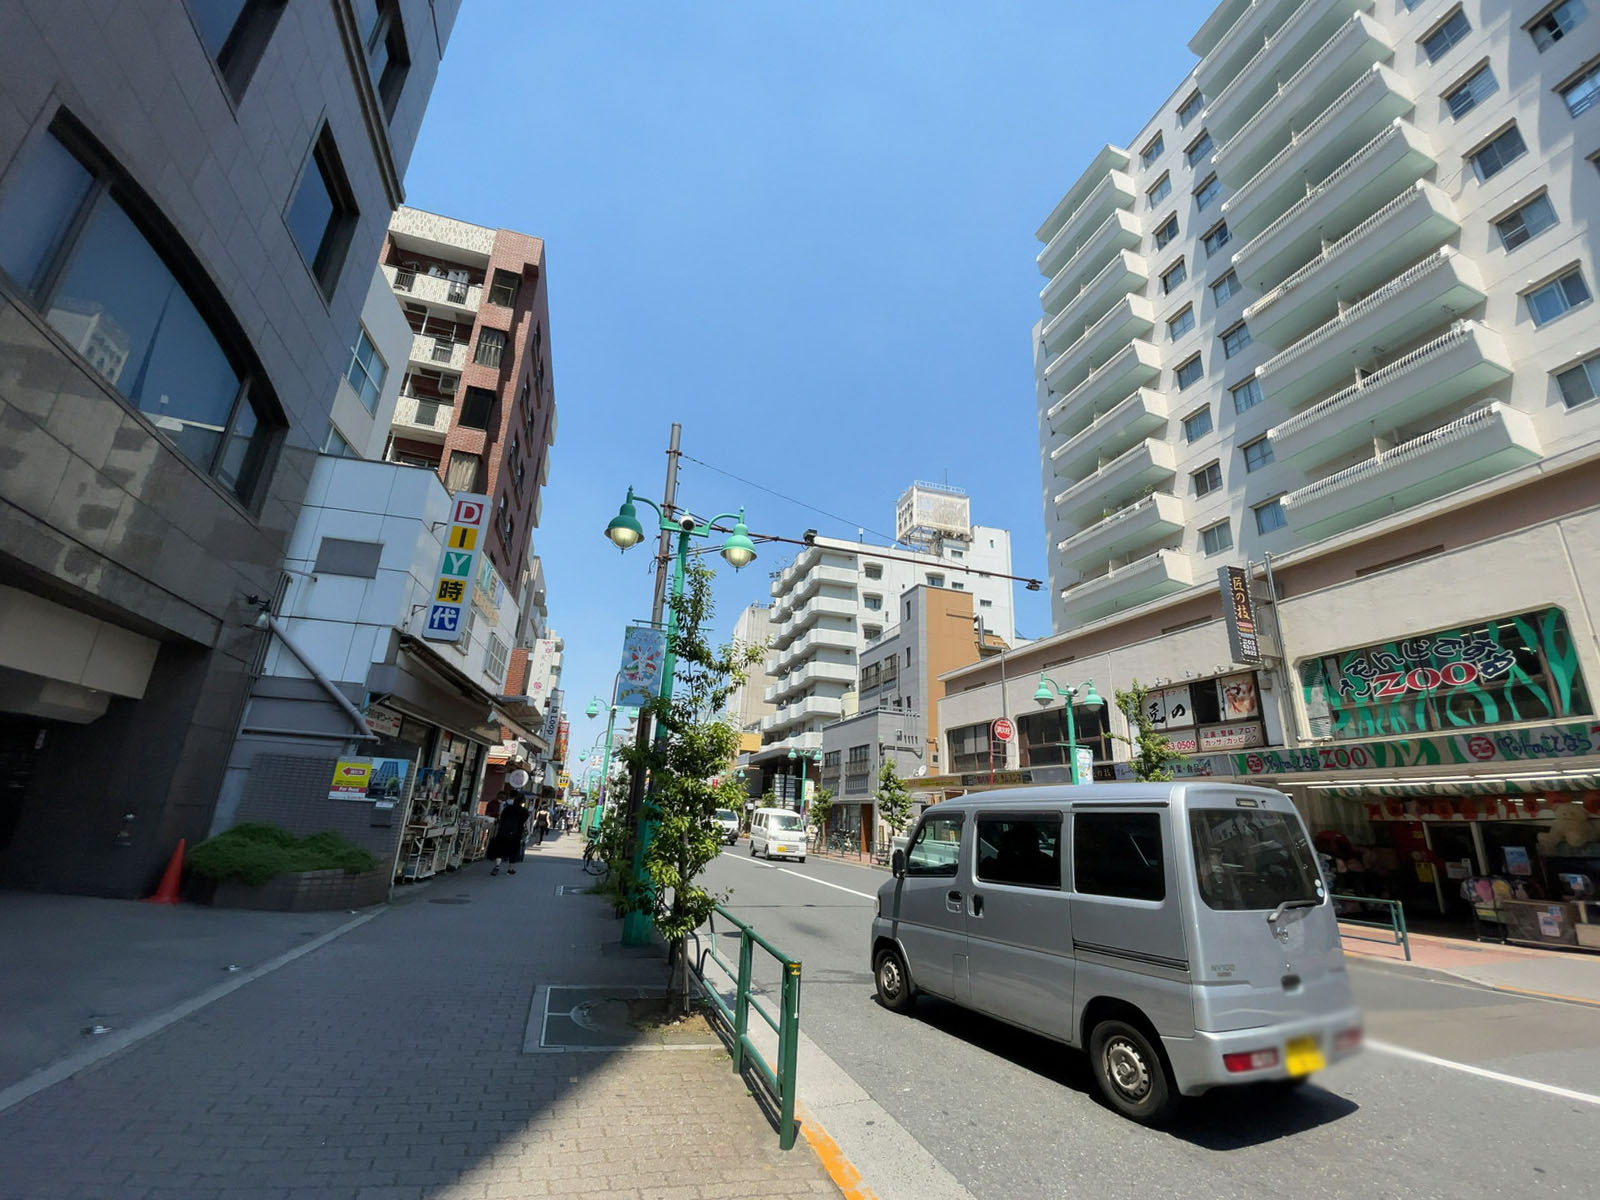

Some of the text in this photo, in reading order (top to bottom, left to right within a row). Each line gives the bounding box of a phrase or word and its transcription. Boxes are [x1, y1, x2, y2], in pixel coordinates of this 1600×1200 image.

[433, 502, 481, 630] DIY時代
[1233, 577, 1250, 620] 匠の技
[1373, 662, 1478, 697] ZOO
[547, 715, 558, 735] Loop
[1319, 747, 1368, 769] ZOO
[1497, 732, 1593, 755] ペットのことなら
